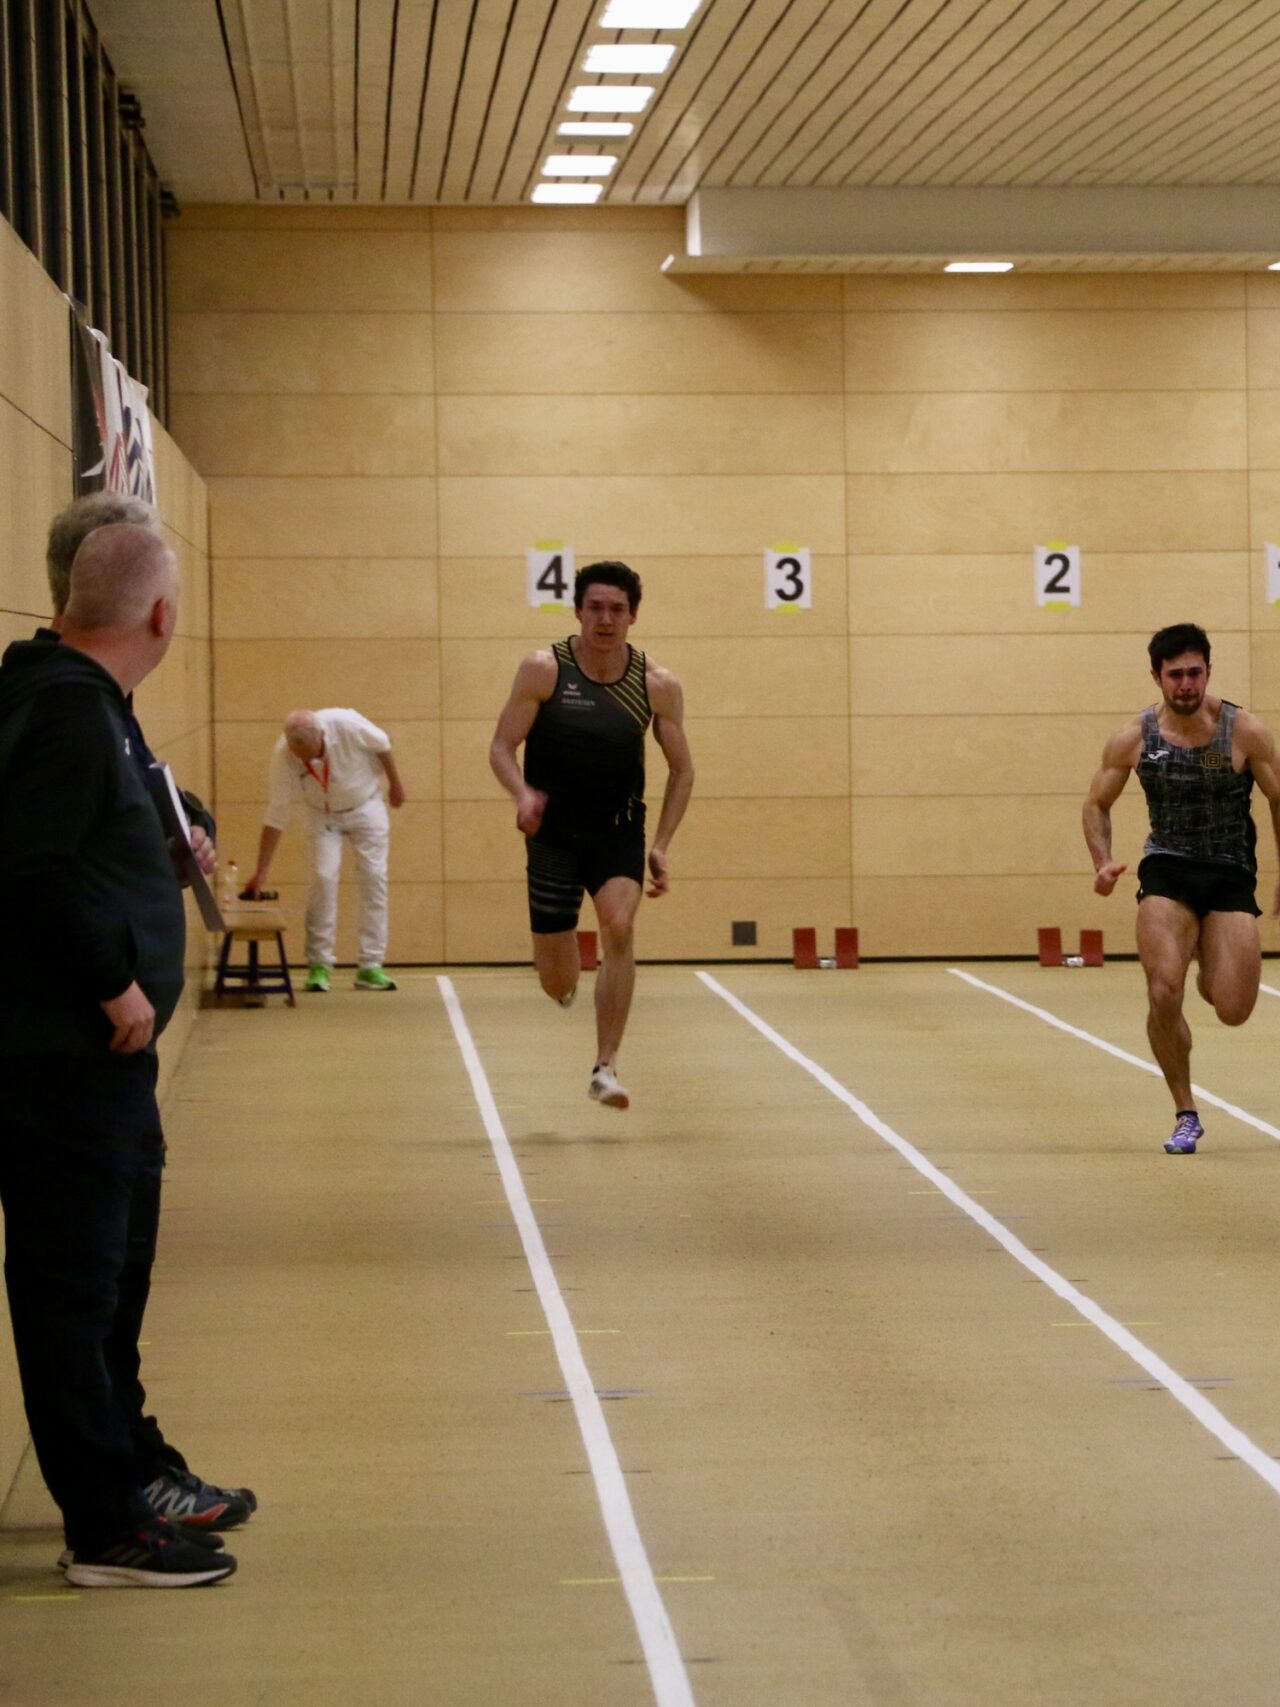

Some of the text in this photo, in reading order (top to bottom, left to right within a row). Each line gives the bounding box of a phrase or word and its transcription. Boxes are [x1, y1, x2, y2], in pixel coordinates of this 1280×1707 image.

[536, 555, 569, 600] 4
[775, 557, 804, 602] 3
[1043, 552, 1071, 594] 2
